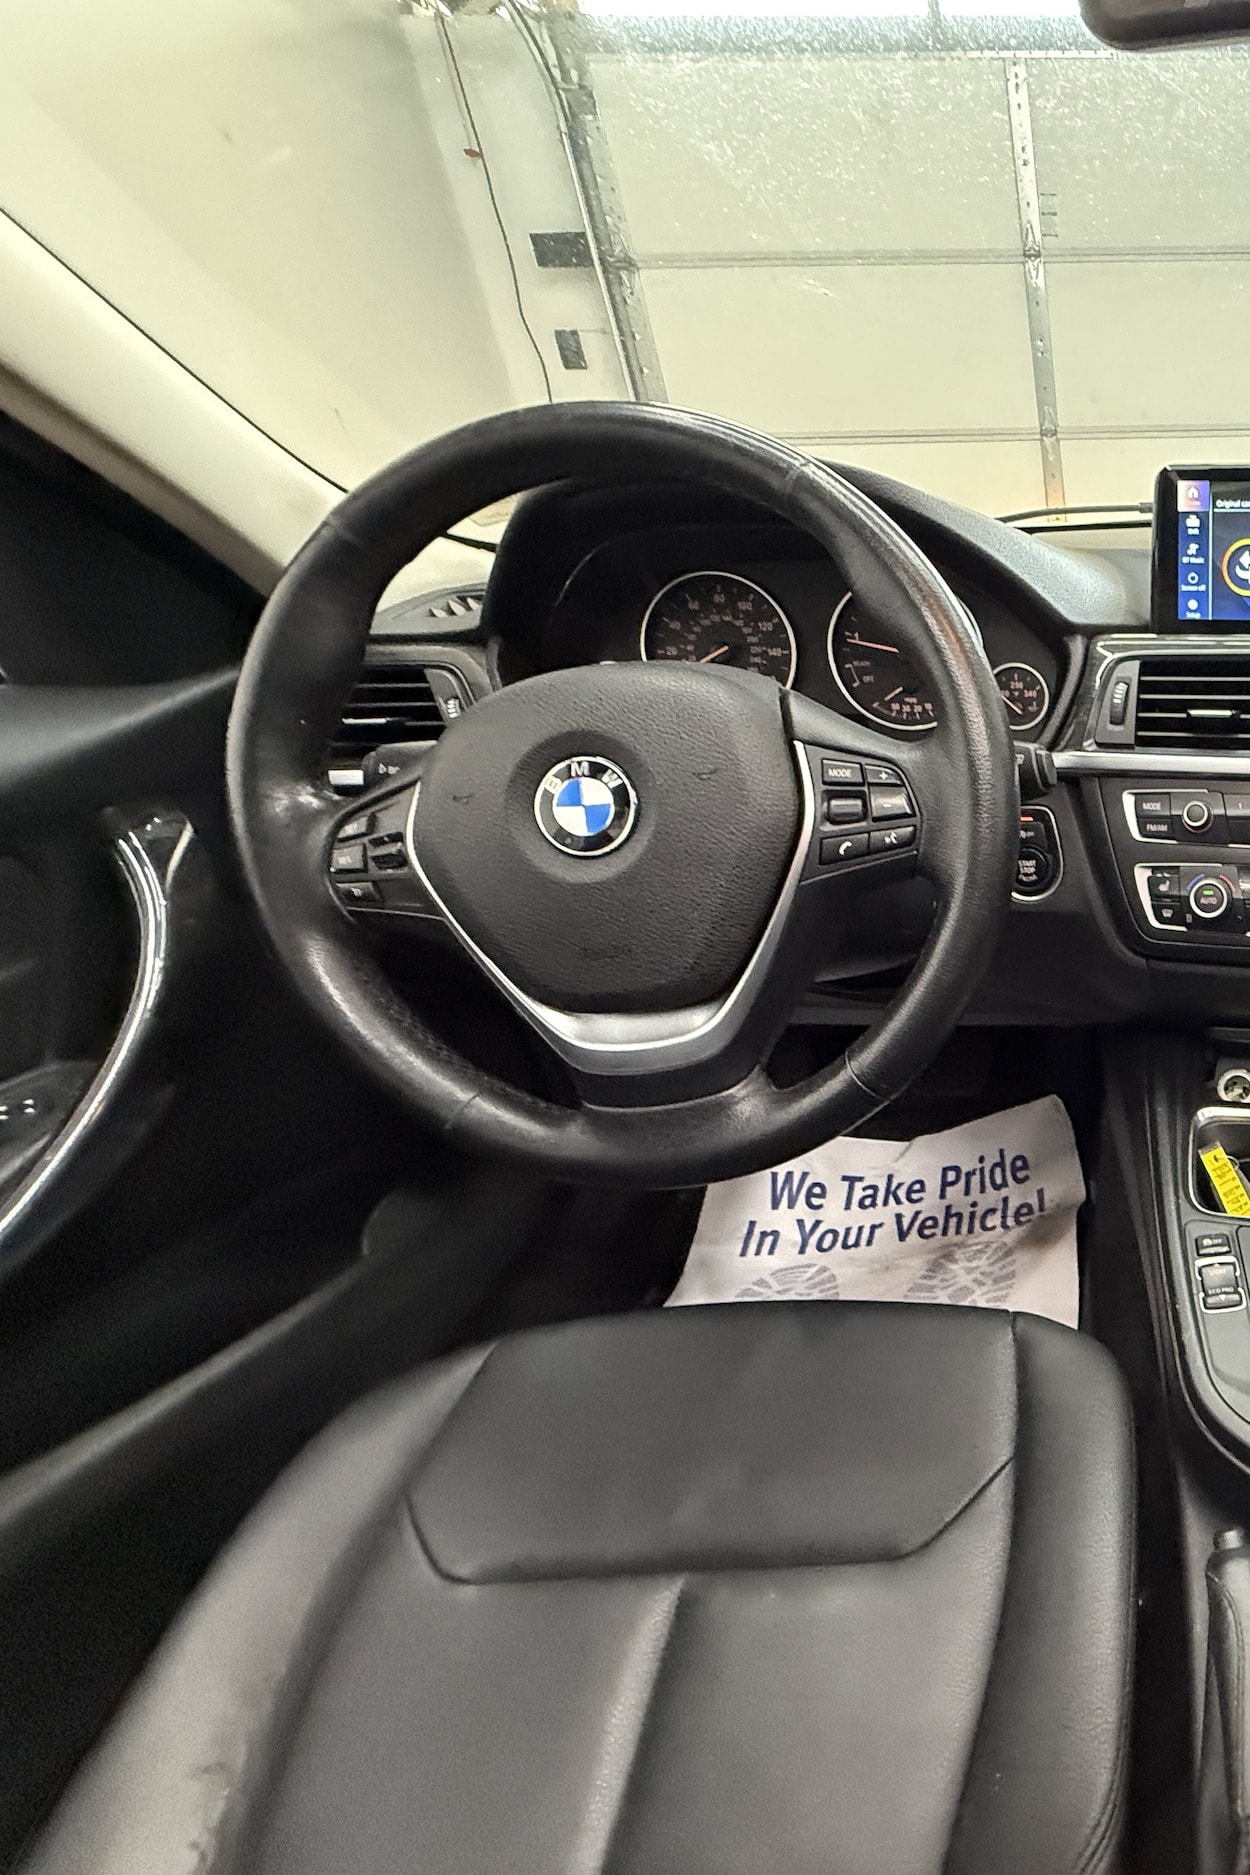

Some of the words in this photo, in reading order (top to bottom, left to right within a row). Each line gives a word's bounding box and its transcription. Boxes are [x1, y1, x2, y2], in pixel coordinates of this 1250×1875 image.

[758, 621, 773, 632] 120
[666, 646, 678, 656] 20
[544, 761, 623, 795] BMW
[827, 768, 852, 778] MODE
[1142, 802, 1162, 811] MODE
[1200, 897, 1217, 905] AUTO
[770, 1170, 827, 1211] We
[840, 1173, 927, 1211] Take
[939, 1148, 1031, 1200] Pride
[738, 1220, 780, 1258] In
[795, 1218, 885, 1256] Your
[894, 1187, 1046, 1243] Vehicle!
